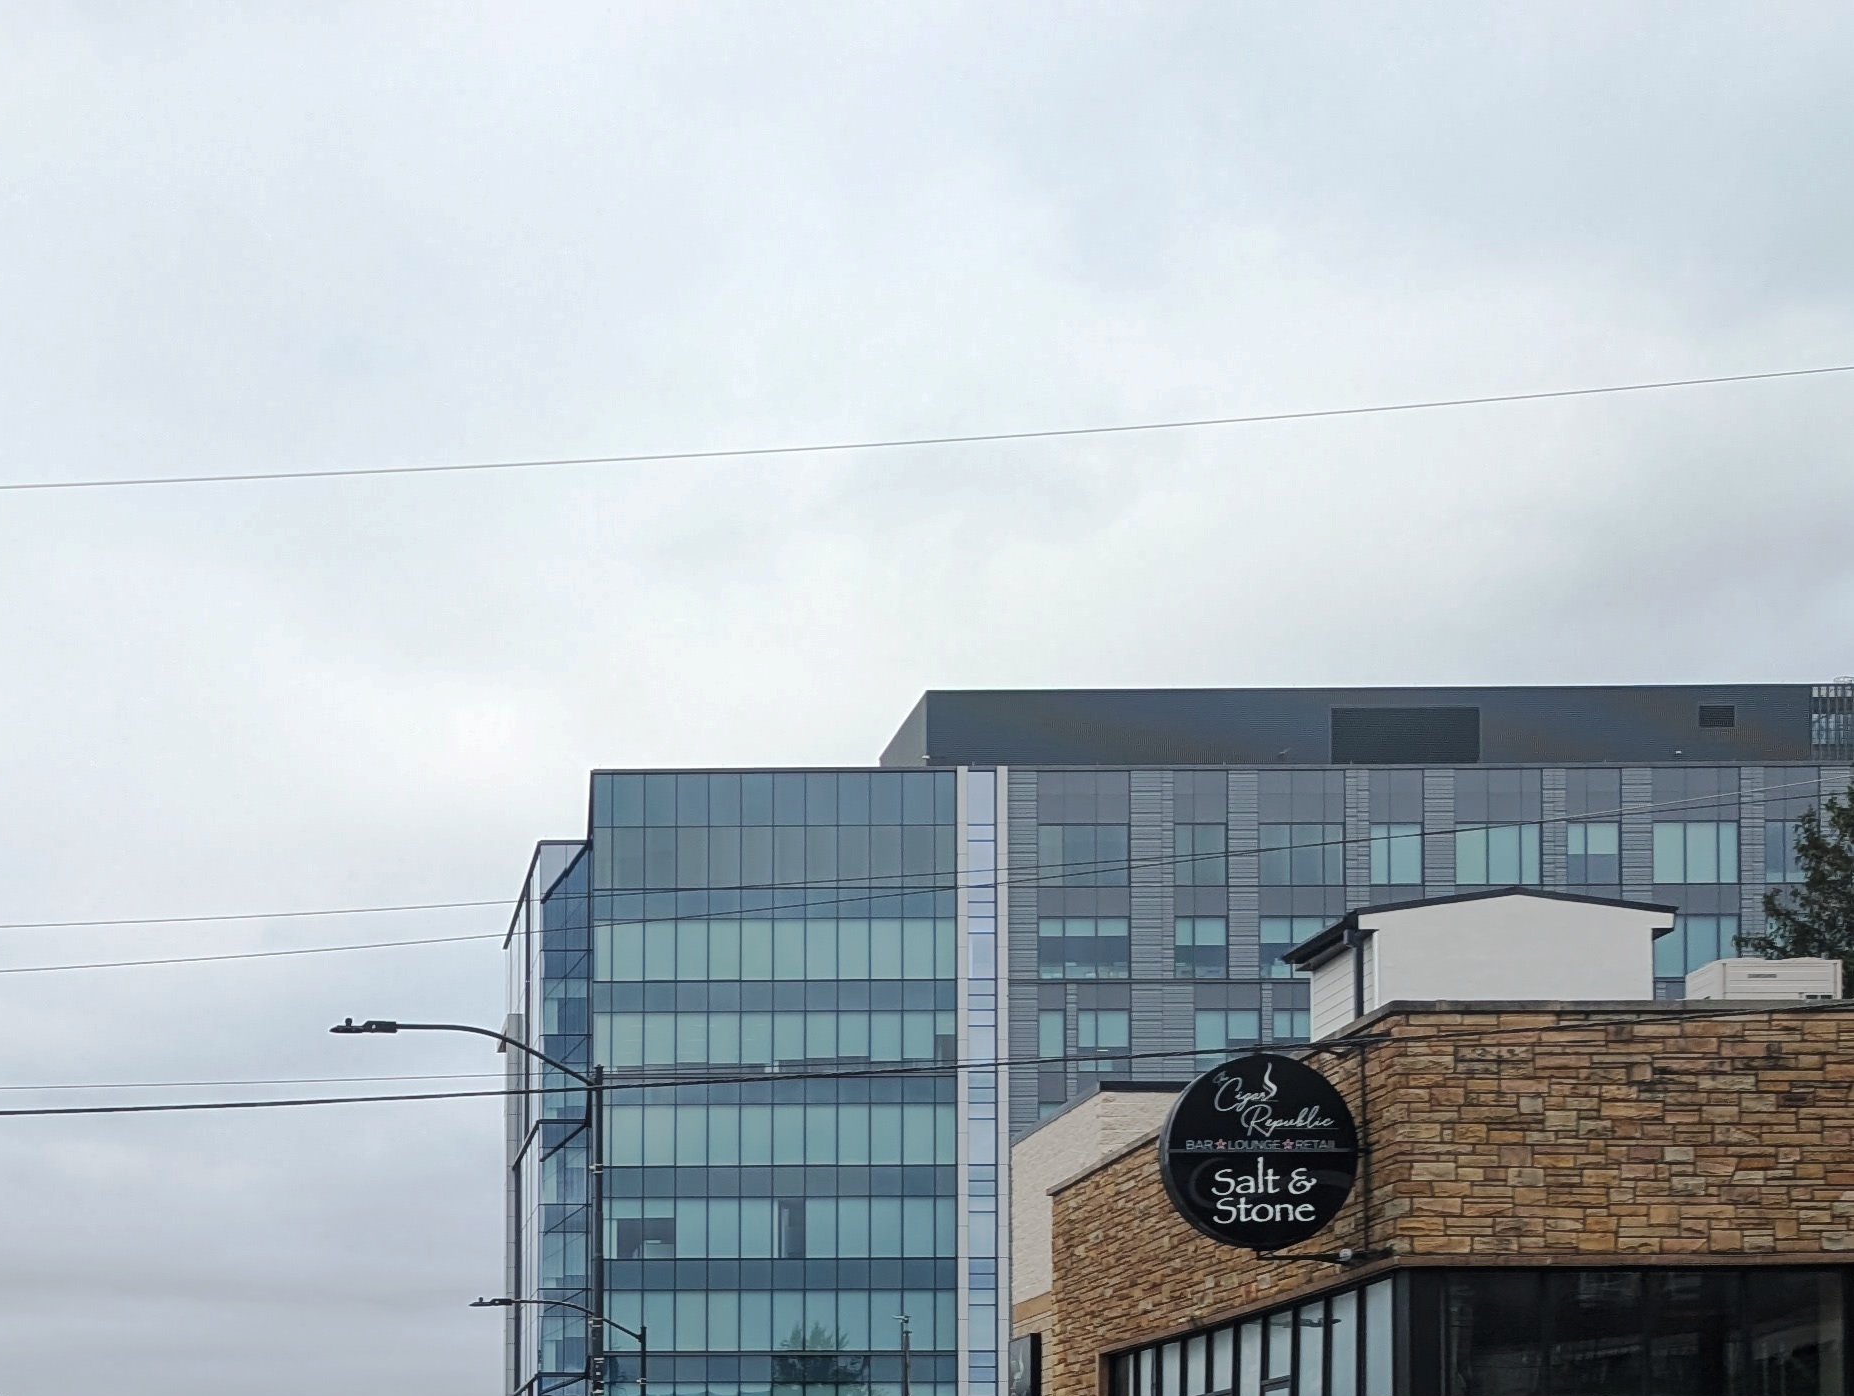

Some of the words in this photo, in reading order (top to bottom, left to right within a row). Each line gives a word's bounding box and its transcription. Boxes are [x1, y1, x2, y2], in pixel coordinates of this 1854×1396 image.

[1214, 1077, 1267, 1112] Cigar
[1240, 1104, 1335, 1138] Republic
[1186, 1139, 1213, 1150] BAR
[1228, 1139, 1280, 1150] LOUNGE
[1296, 1139, 1336, 1150] RETAIL
[1211, 1156, 1282, 1196] Salt
[1287, 1167, 1318, 1195] &
[1212, 1196, 1316, 1225] Stone
